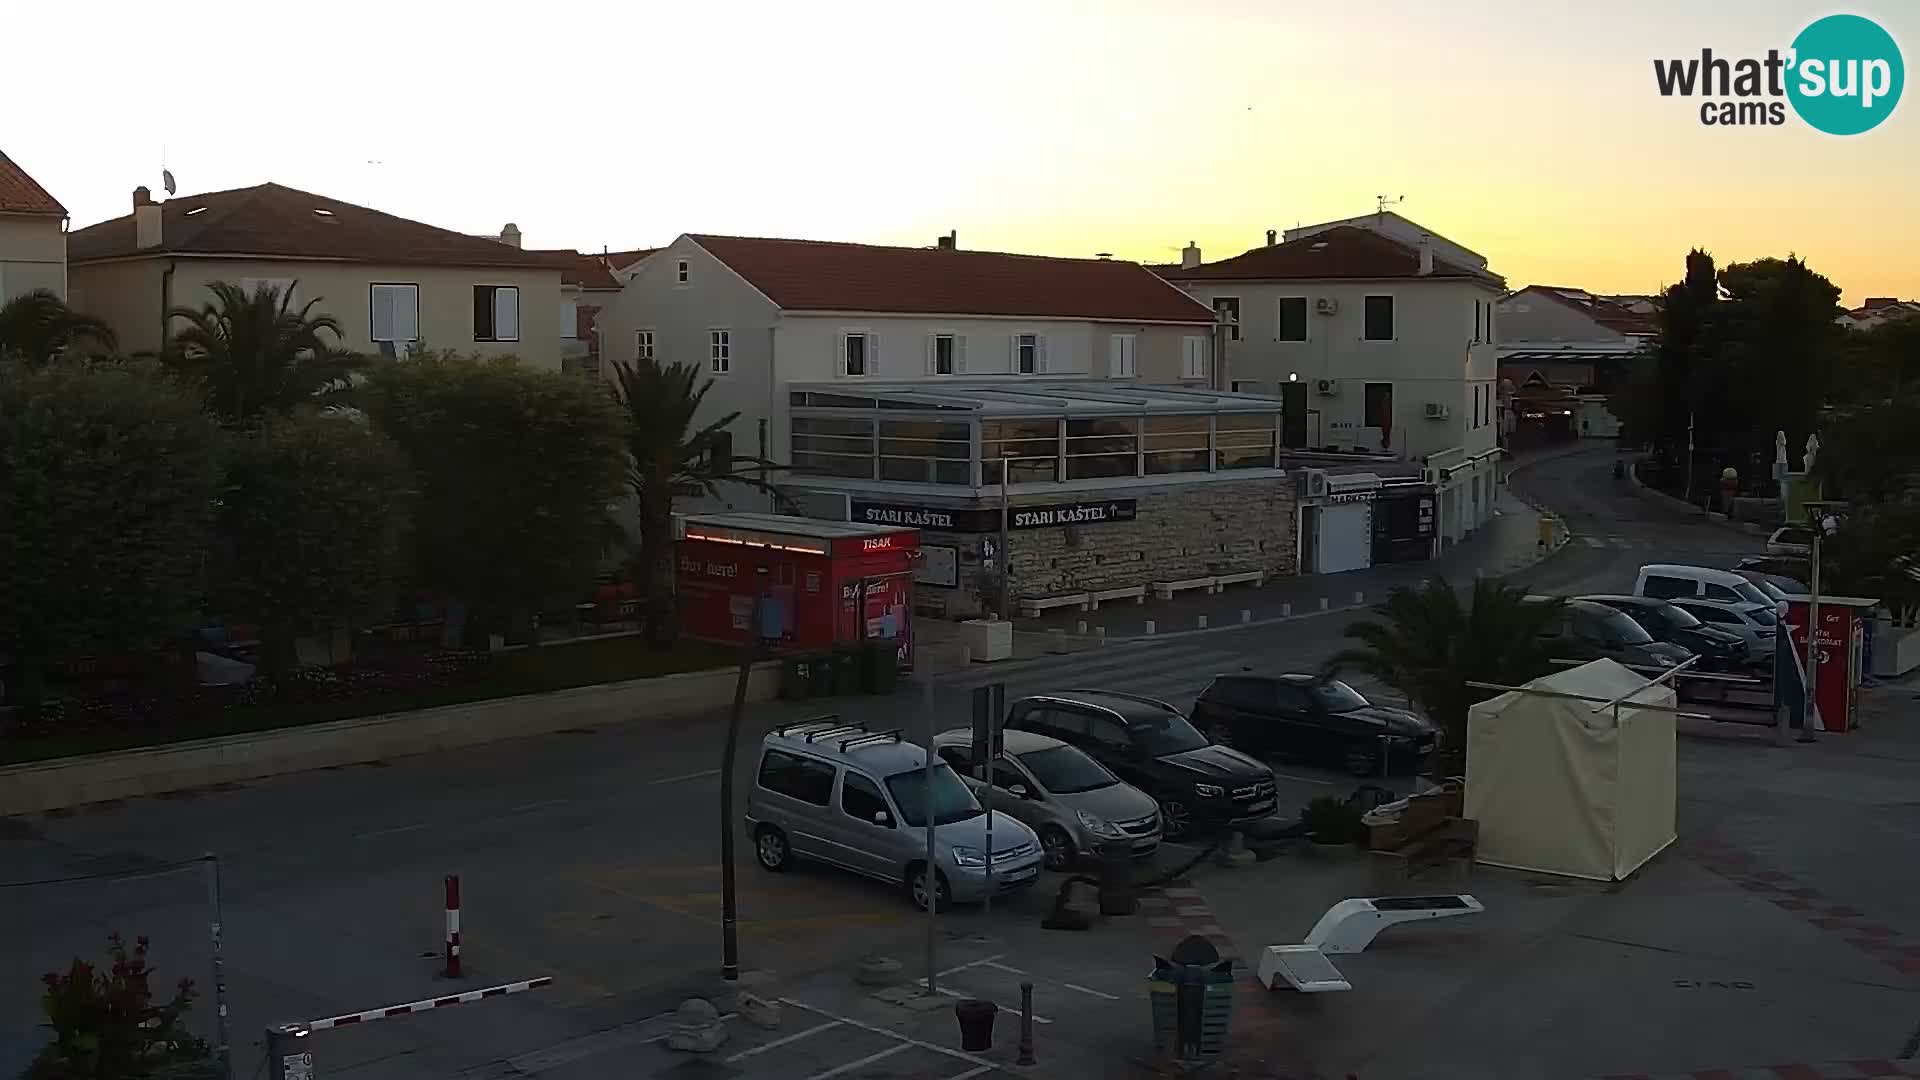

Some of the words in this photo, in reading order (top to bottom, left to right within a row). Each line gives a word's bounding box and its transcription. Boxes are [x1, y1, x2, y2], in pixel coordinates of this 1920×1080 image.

[866, 508, 903, 523] STARI
[905, 510, 954, 528] KAŠTEL
[1016, 510, 1053, 527] STARI
[1057, 506, 1105, 523] KAŠTEL
[863, 537, 891, 549] TISAK
